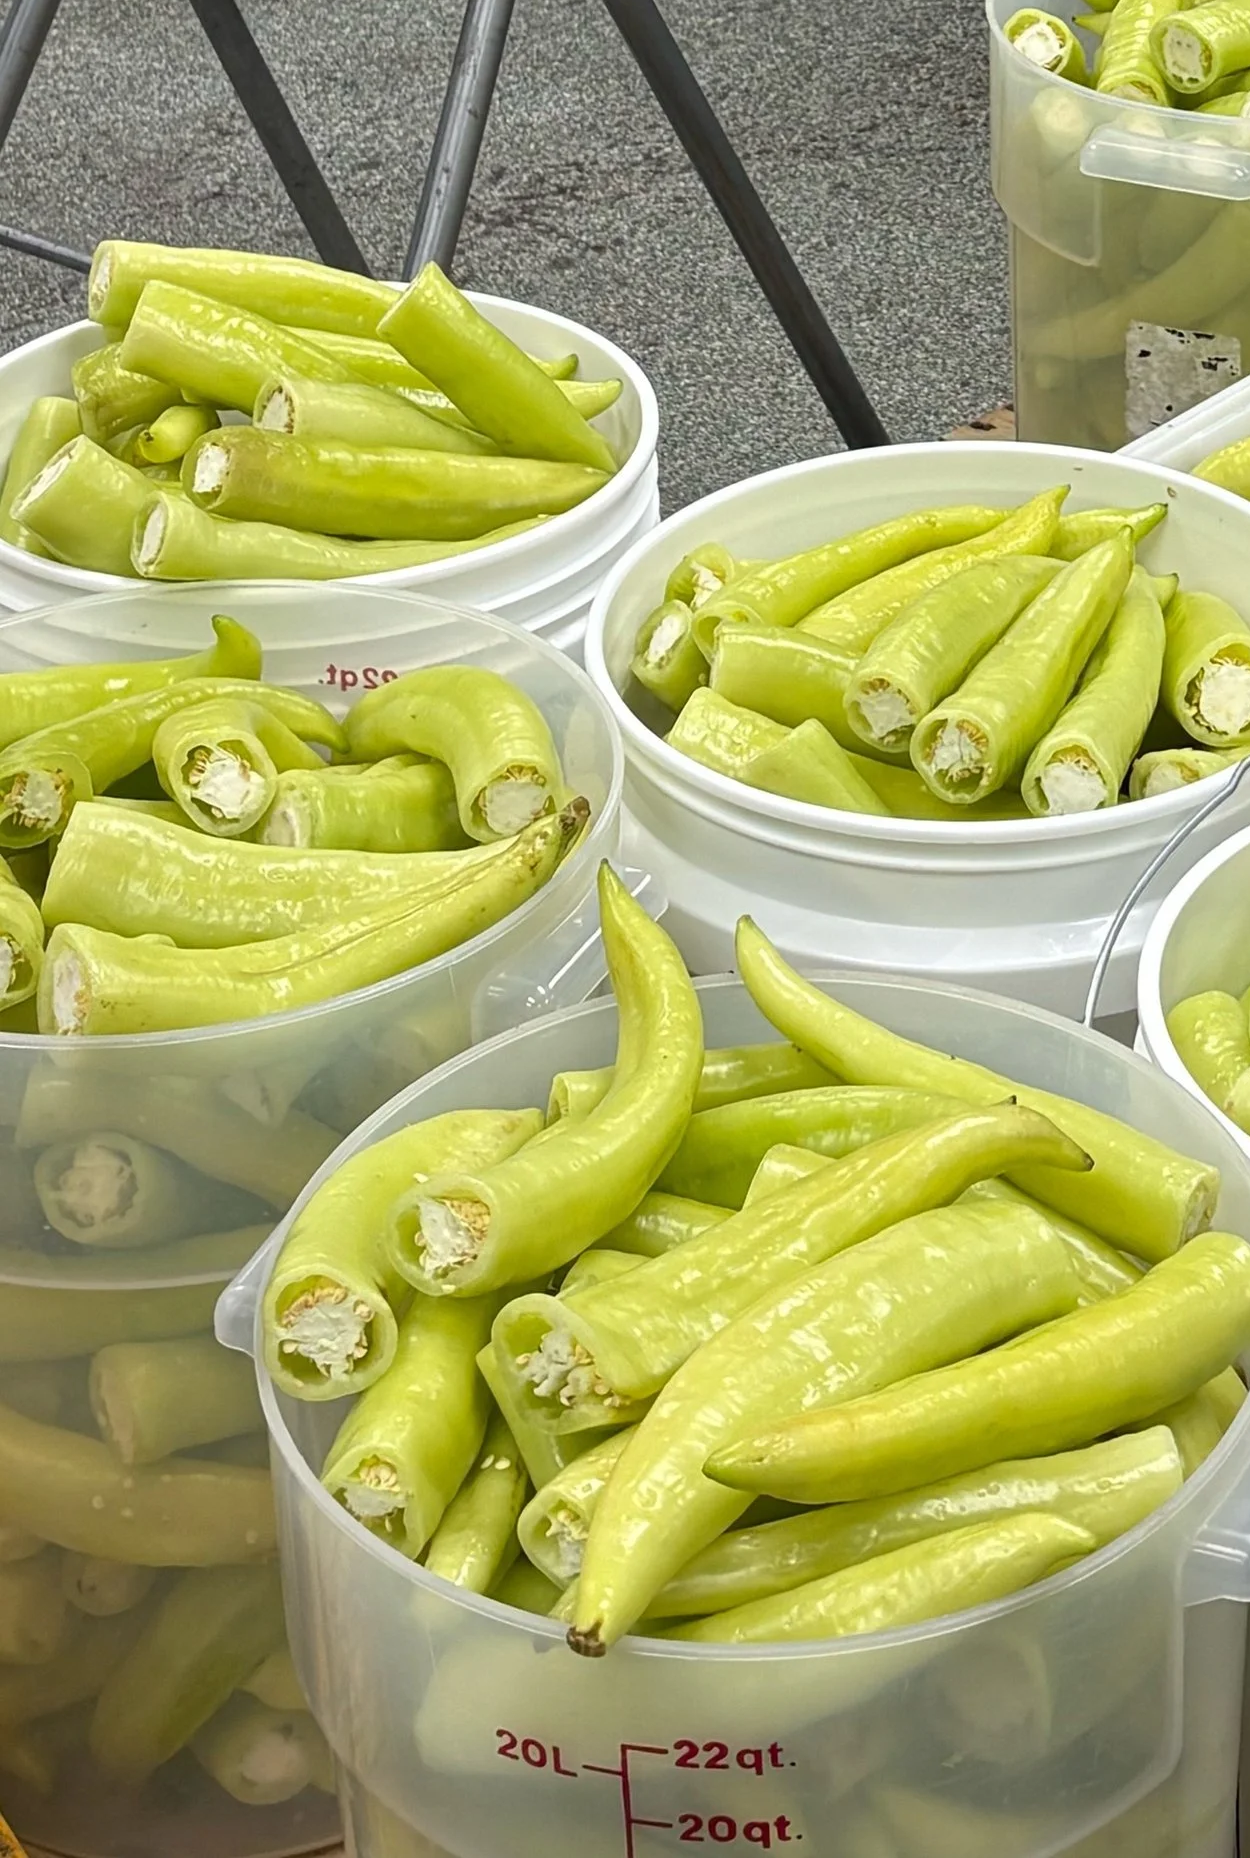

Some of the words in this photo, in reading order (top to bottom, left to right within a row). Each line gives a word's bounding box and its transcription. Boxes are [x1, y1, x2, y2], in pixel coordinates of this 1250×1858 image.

[496, 1729, 578, 1778] 20L
[673, 1739, 797, 1777] 22qt.
[678, 1813, 803, 1850] 20qt.
